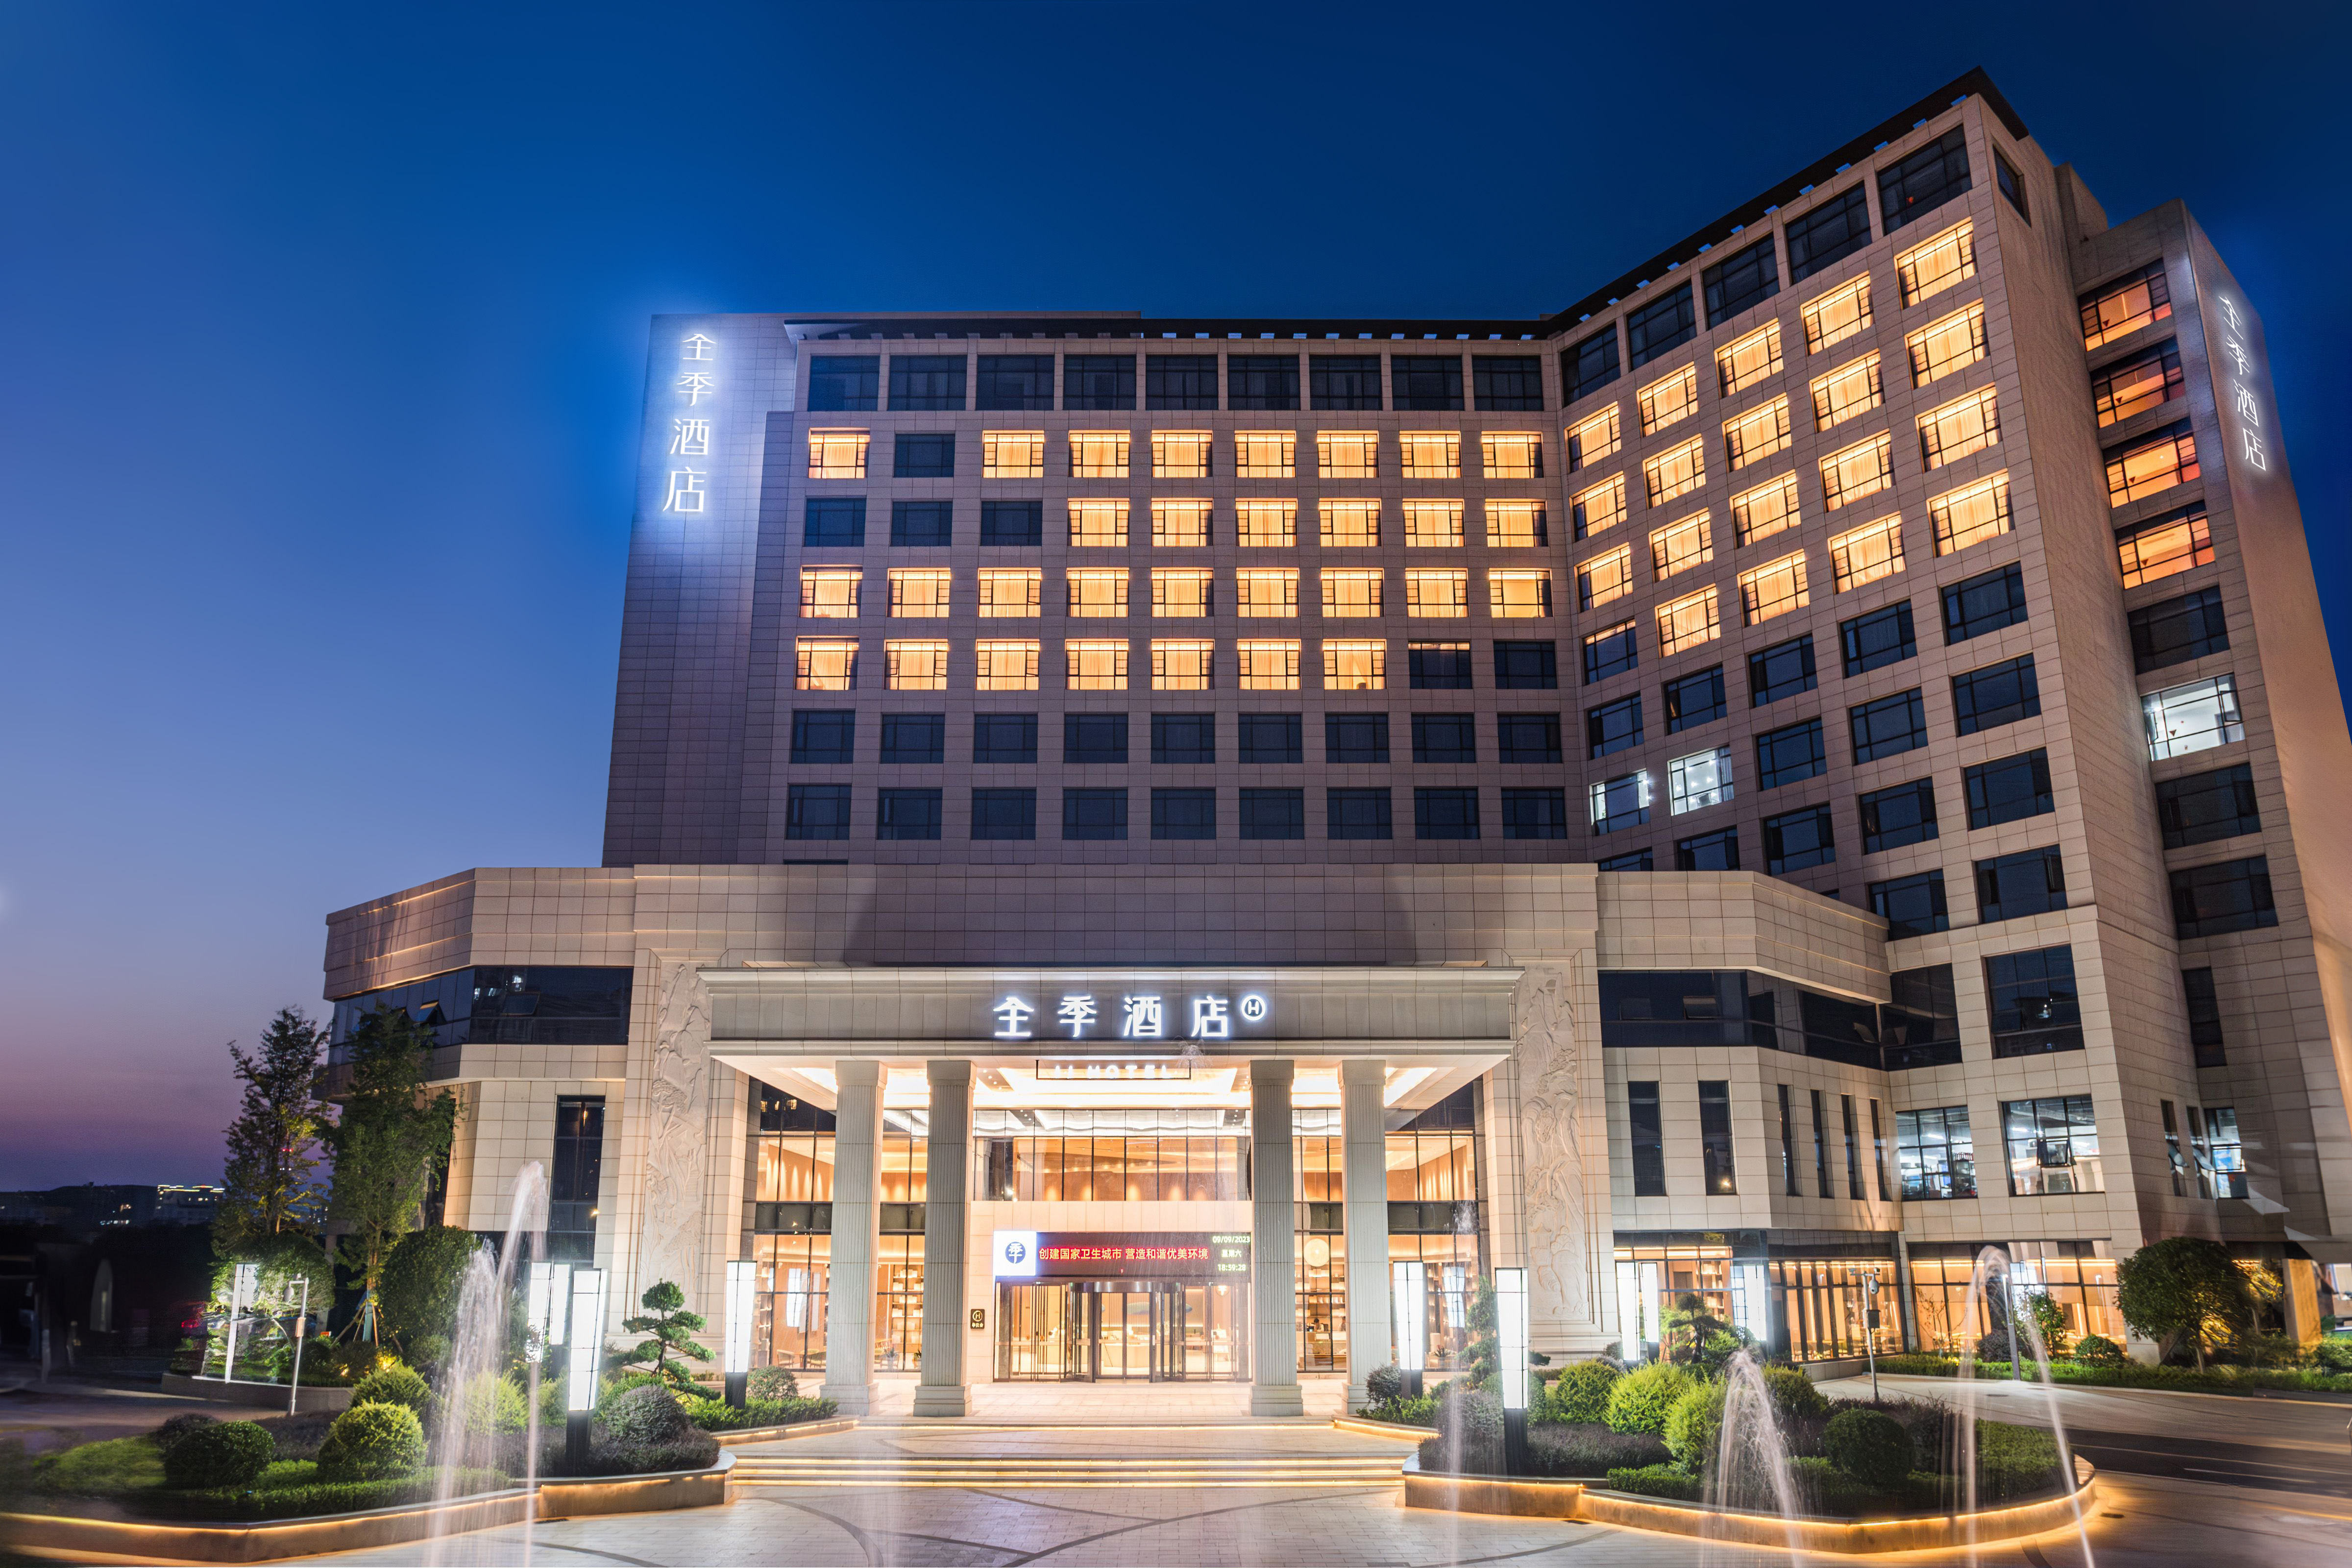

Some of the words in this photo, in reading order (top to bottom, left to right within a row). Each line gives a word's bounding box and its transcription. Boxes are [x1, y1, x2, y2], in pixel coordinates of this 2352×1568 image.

[2219, 295, 2266, 471] 全季酒店
[662, 333, 716, 513] 全季酒店
[993, 995, 1228, 1038] 全季酒店
[1087, 1065, 1174, 1078] HOTEL
[1039, 1248, 1122, 1260] 创建国家卫生城市
[1125, 1248, 1209, 1260] 营造和谐优美环境
